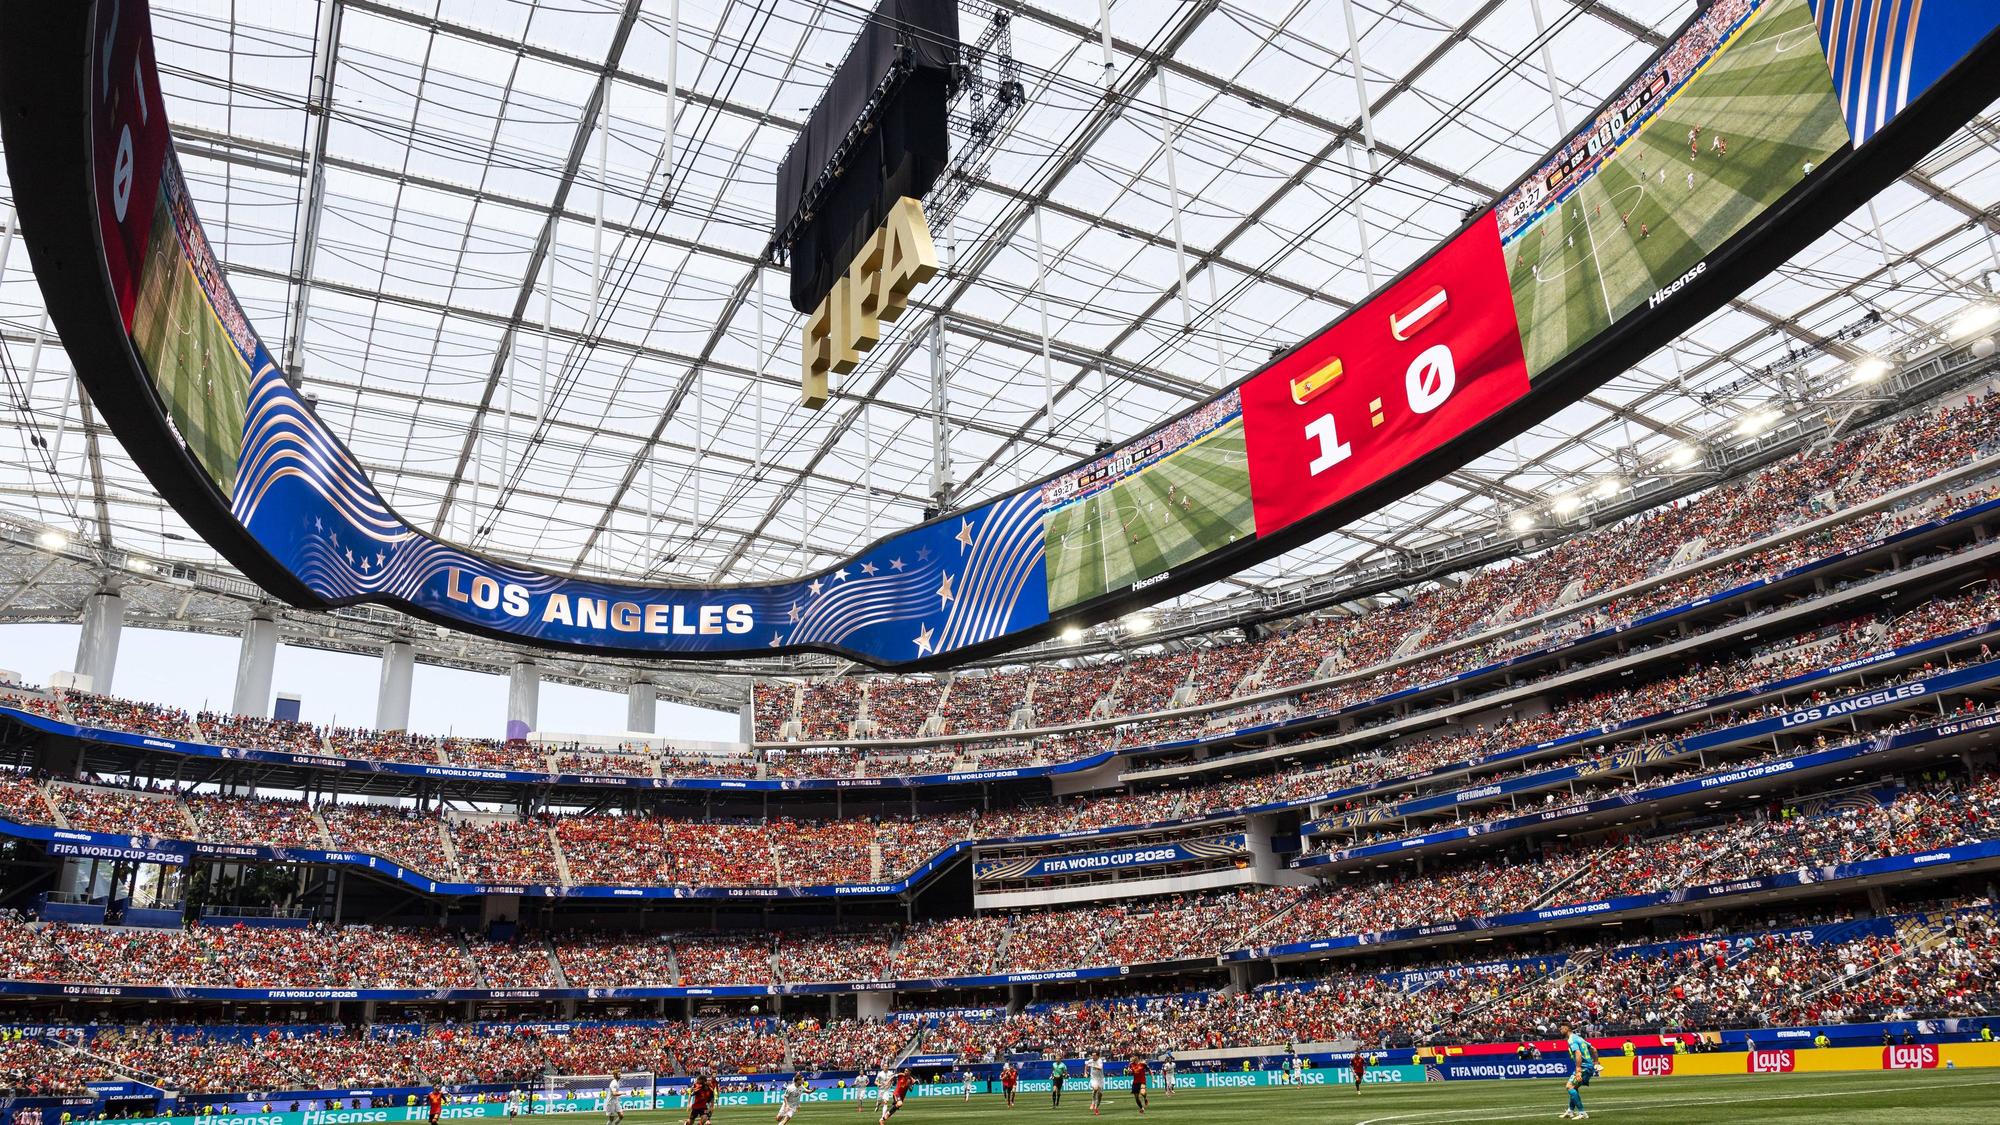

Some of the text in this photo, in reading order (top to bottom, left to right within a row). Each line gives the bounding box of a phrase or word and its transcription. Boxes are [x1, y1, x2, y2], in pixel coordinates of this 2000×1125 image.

[1513, 188, 1540, 217] 49:27
[1572, 150, 1586, 168] ESP
[1614, 118, 1621, 130] 0
[1649, 261, 1707, 310] Hisense
[802, 196, 939, 411] FIFA
[1304, 412, 1352, 477] 1
[1406, 344, 1456, 414] 0
[1053, 483, 1074, 498] 49:27
[1132, 570, 1170, 592] Hisense
[446, 566, 755, 636] LOS ANGELES
[1841, 660, 1862, 670] WORLD
[1862, 657, 1874, 665] CUP
[1782, 683, 1926, 727] LOS ANGELES
[1937, 724, 1958, 736] LOS
[310, 758, 346, 767] ANGELES
[468, 770, 482, 778] CUP
[580, 776, 626, 785] LOS ANGELES
[1701, 762, 1795, 788] FIFA WORLD CUP 2026
[1542, 804, 1589, 820] LOS ANGELES
[54, 844, 184, 864] FIFA WORLD CUP 2026
[196, 844, 258, 856] LOS ANGELES
[1044, 848, 1176, 872] FIFA WORLD CUP 2026
[487, 886, 524, 894] ANGELES
[1708, 880, 1762, 894] LOS ANGELES
[1538, 902, 1611, 919] FIFA WORLD CUP 2026
[1406, 973, 1424, 982] FIFA
[64, 986, 122, 995] LOS ANGELES
[1638, 1054, 1670, 1075] Lay's
[1752, 1050, 1790, 1072] Lay's
[1890, 1044, 1935, 1069] Lay's
[1338, 1067, 1402, 1084] Hiense
[1451, 1063, 1564, 1077] FIFA WORLD CUP 2026
[1206, 1072, 1256, 1088] Hisense
[303, 1108, 388, 1125] Hisense
[406, 1104, 486, 1120] Hiense
